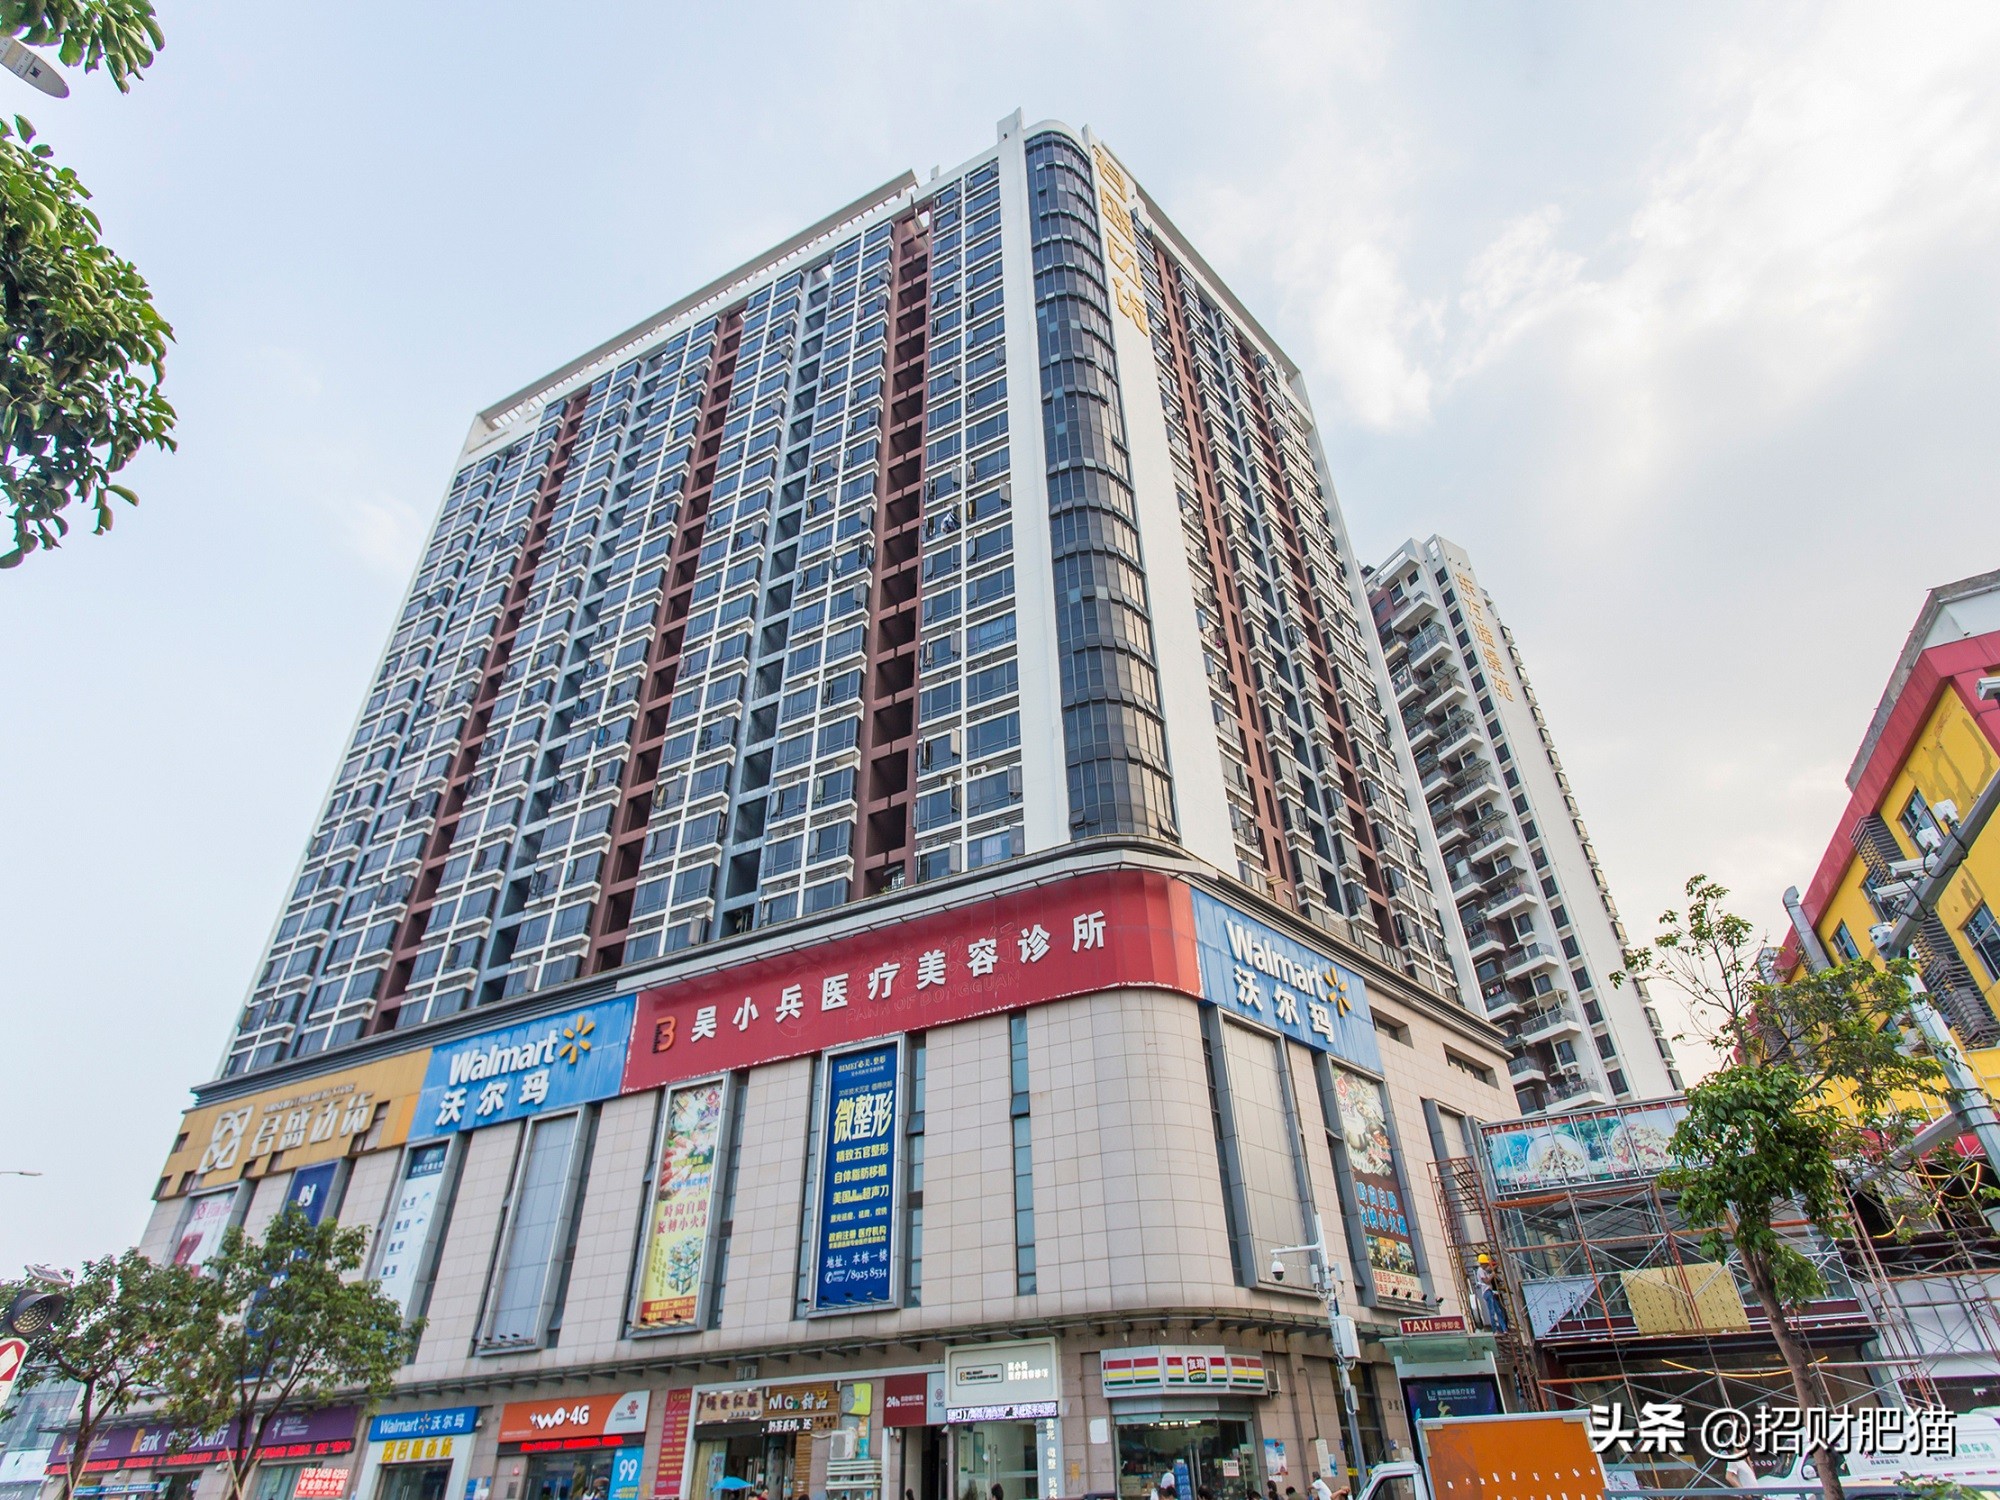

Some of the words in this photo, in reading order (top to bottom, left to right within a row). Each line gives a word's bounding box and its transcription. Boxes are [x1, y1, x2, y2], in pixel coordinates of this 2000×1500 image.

[691, 910, 1106, 1042] 吴小兵医疗美容诊所
[1225, 919, 1327, 1002] Walmart
[1233, 964, 1334, 1044] 沃尔玛
[449, 1029, 558, 1087] Walmart
[250, 1091, 374, 1157] 君盛百货
[435, 1069, 549, 1126] 沃尔玛
[834, 1090, 894, 1144] 微整形
[1404, 1319, 1433, 1332] TAXI
[380, 1416, 419, 1434] Walmart
[430, 1412, 465, 1430] 沃尔玛
[618, 1458, 638, 1482] 99
